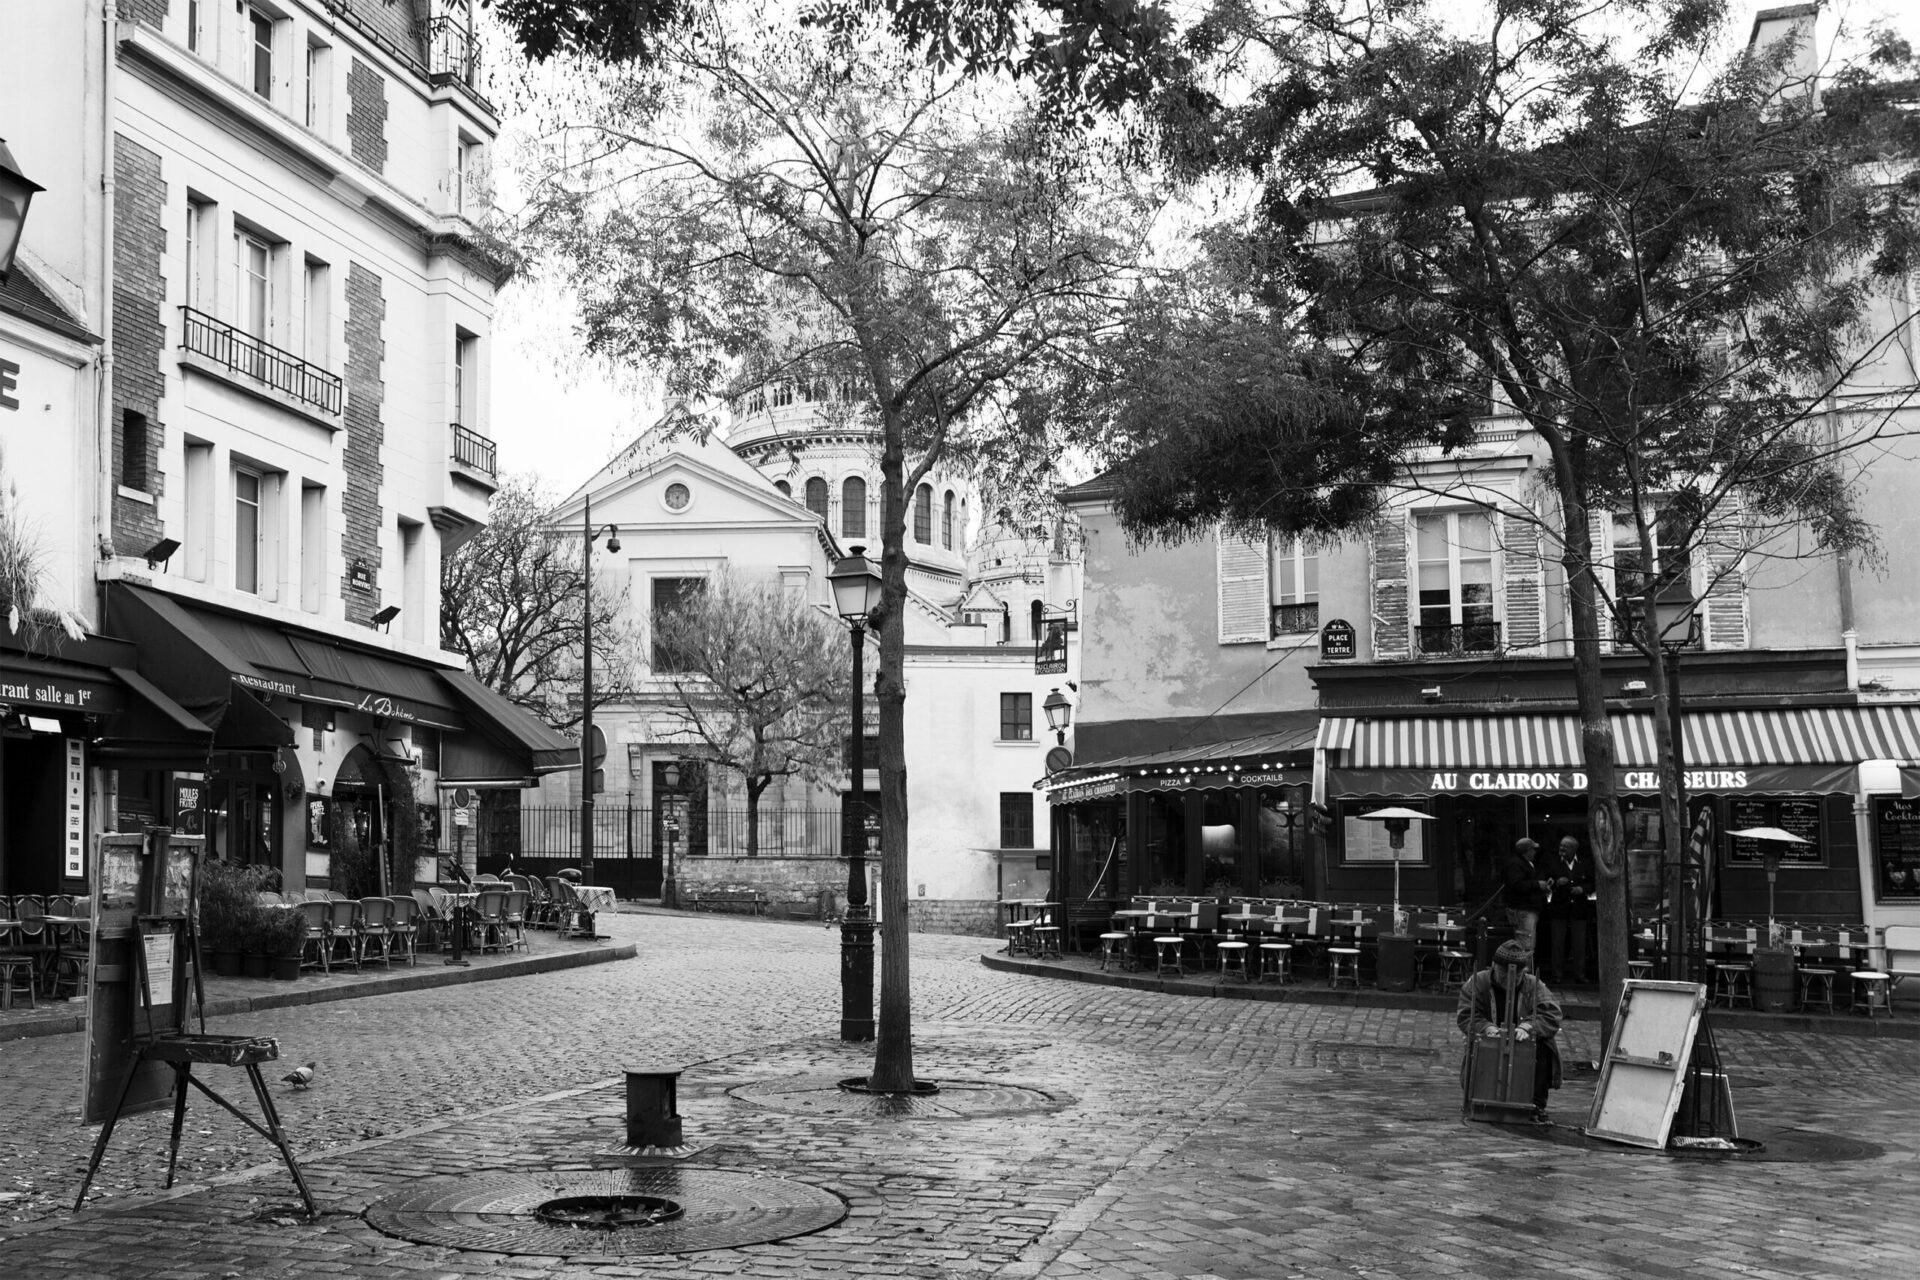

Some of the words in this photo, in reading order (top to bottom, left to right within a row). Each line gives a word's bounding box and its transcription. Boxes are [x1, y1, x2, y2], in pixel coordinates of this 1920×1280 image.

[357, 572, 366, 581] RUE
[0, 684, 29, 699] rant
[35, 685, 61, 703] salle
[64, 693, 75, 705] au
[78, 689, 91, 706] 1er
[357, 694, 373, 711] La
[1241, 774, 1283, 783] COCKTAILS
[1431, 773, 1457, 789] AU
[1469, 773, 1560, 789] CLAIRON
[1624, 771, 1747, 789] CHSEURS
[180, 787, 199, 800] MOULES
[179, 797, 197, 809] FRITES
[1893, 801, 1912, 810] Nos
